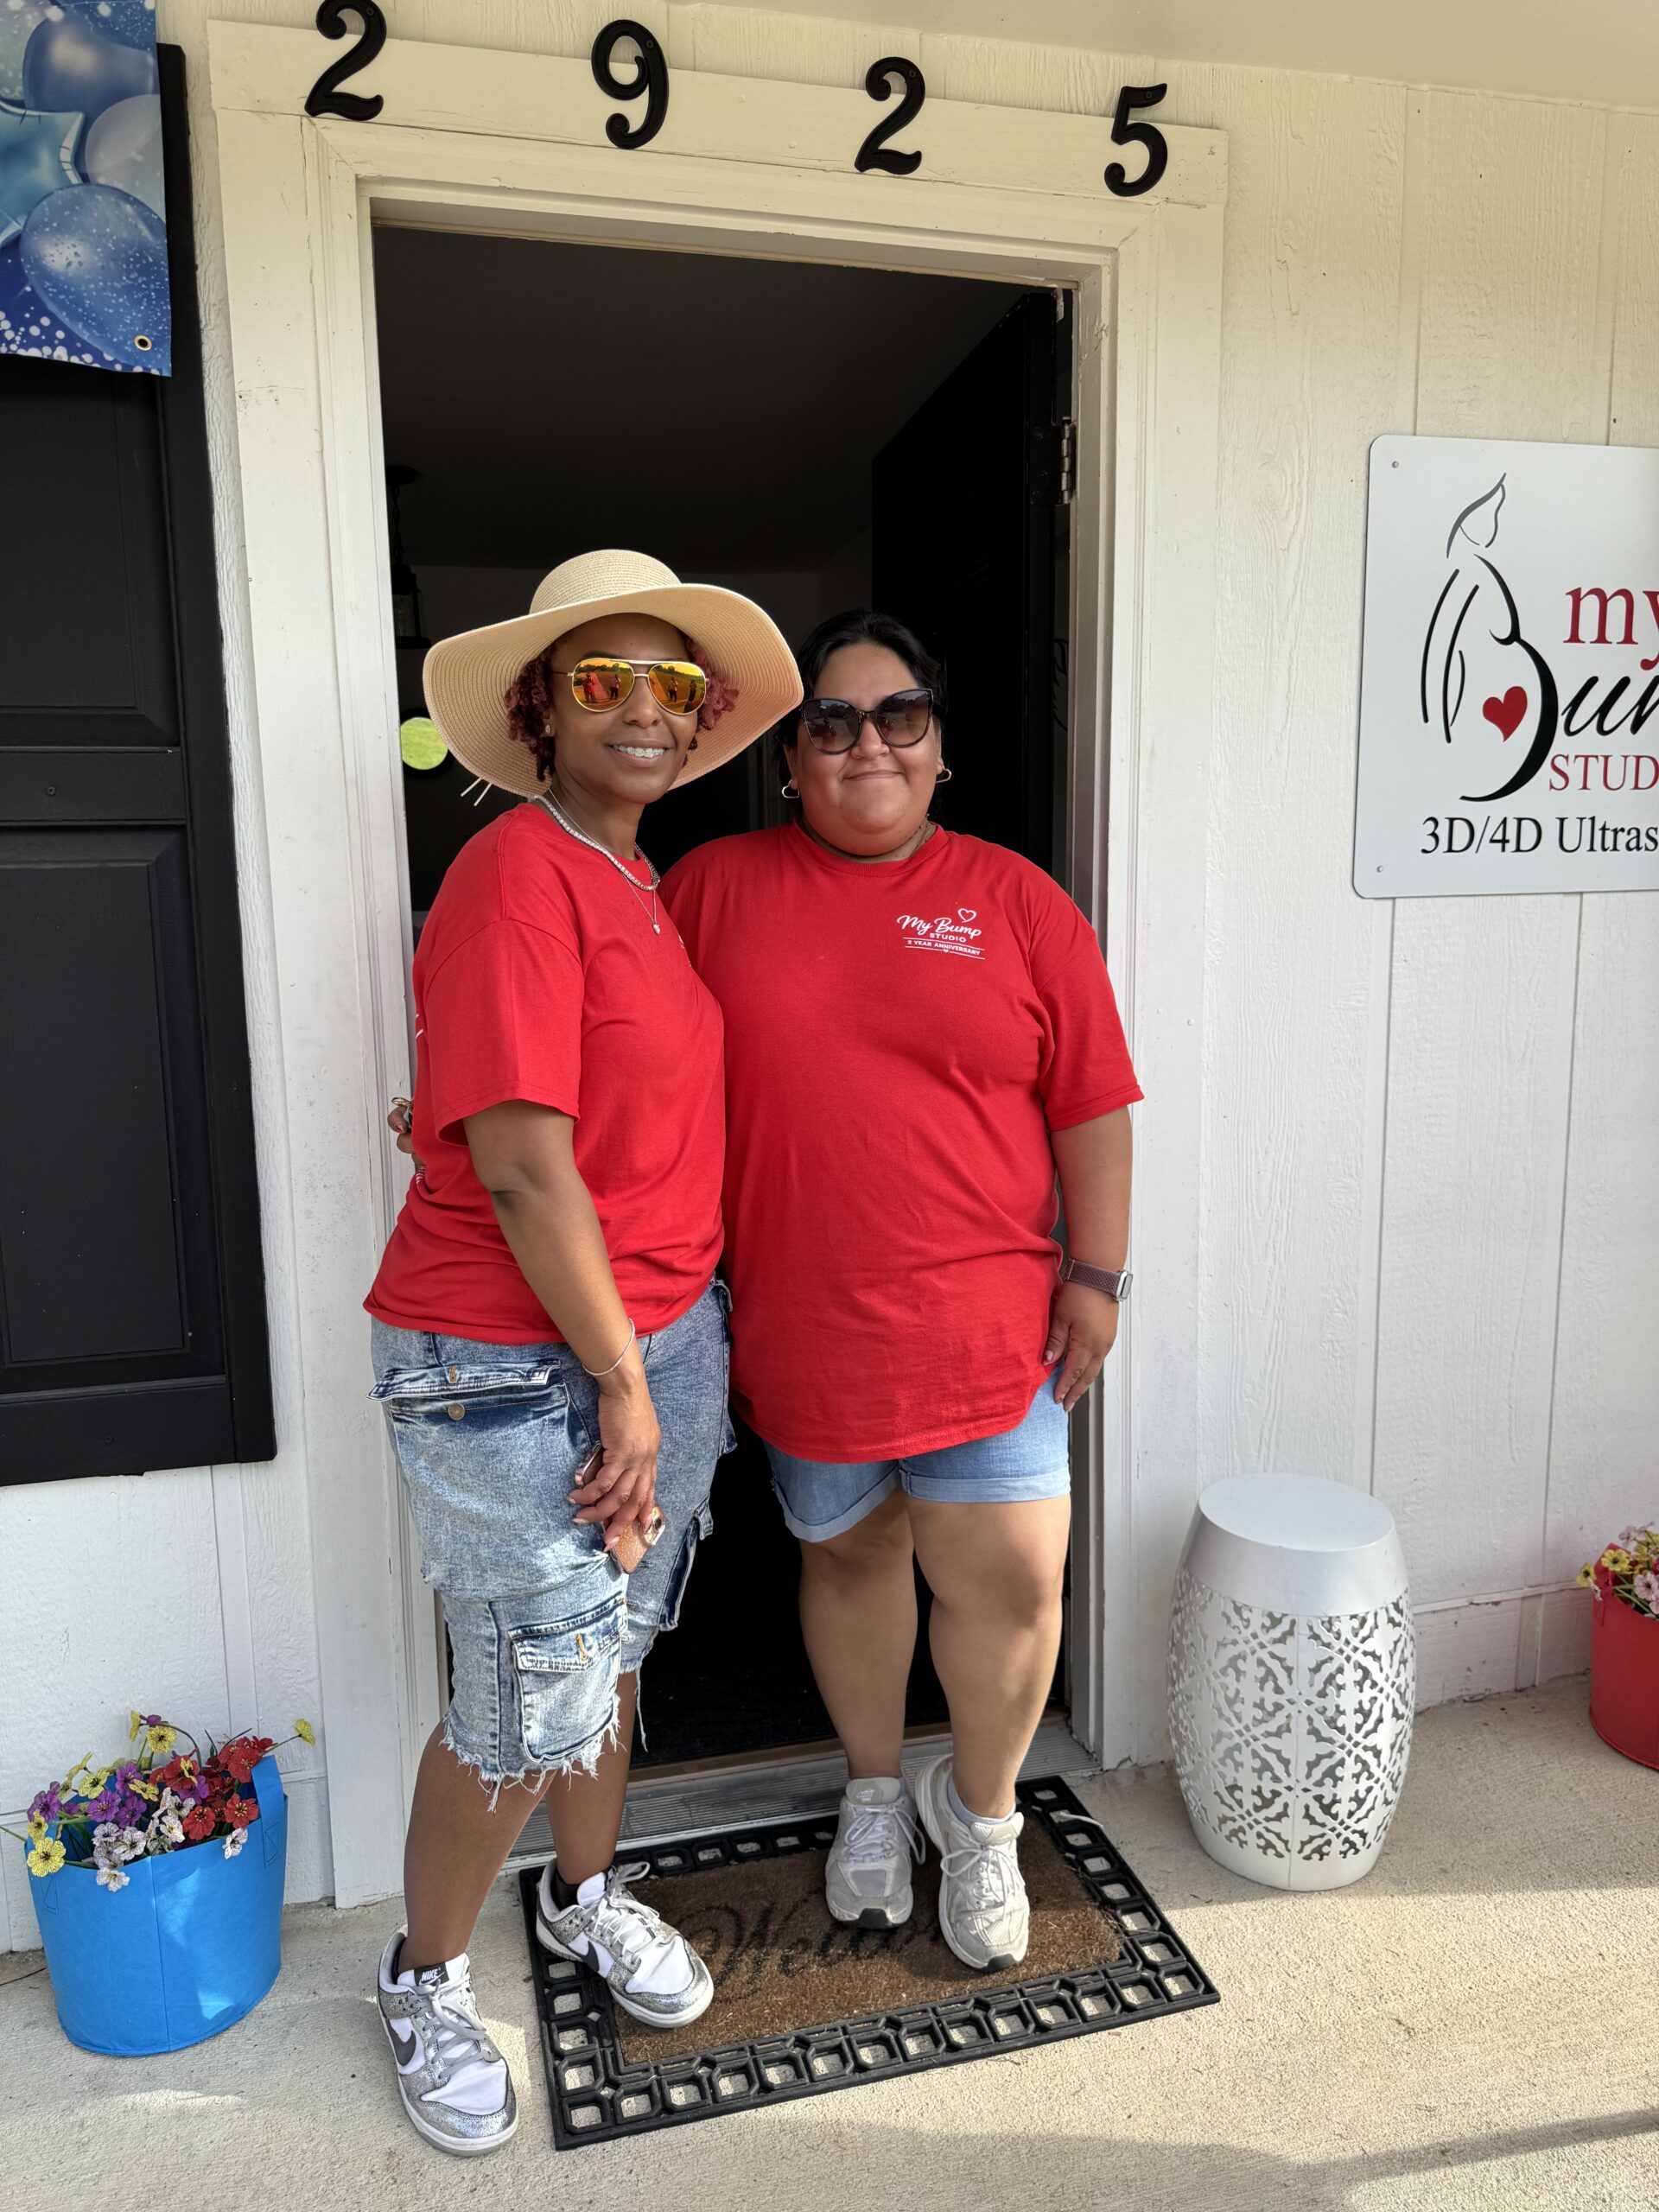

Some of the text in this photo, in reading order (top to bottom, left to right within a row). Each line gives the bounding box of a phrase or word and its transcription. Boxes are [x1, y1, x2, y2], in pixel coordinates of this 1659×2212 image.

[1421, 815, 1542, 855] 3D/4D
[897, 915, 982, 939] My Bump
[929, 933, 967, 943] STUDIO
[934, 943, 981, 956] ANNIVERSARY
[421, 1968, 439, 1982] NIKE
